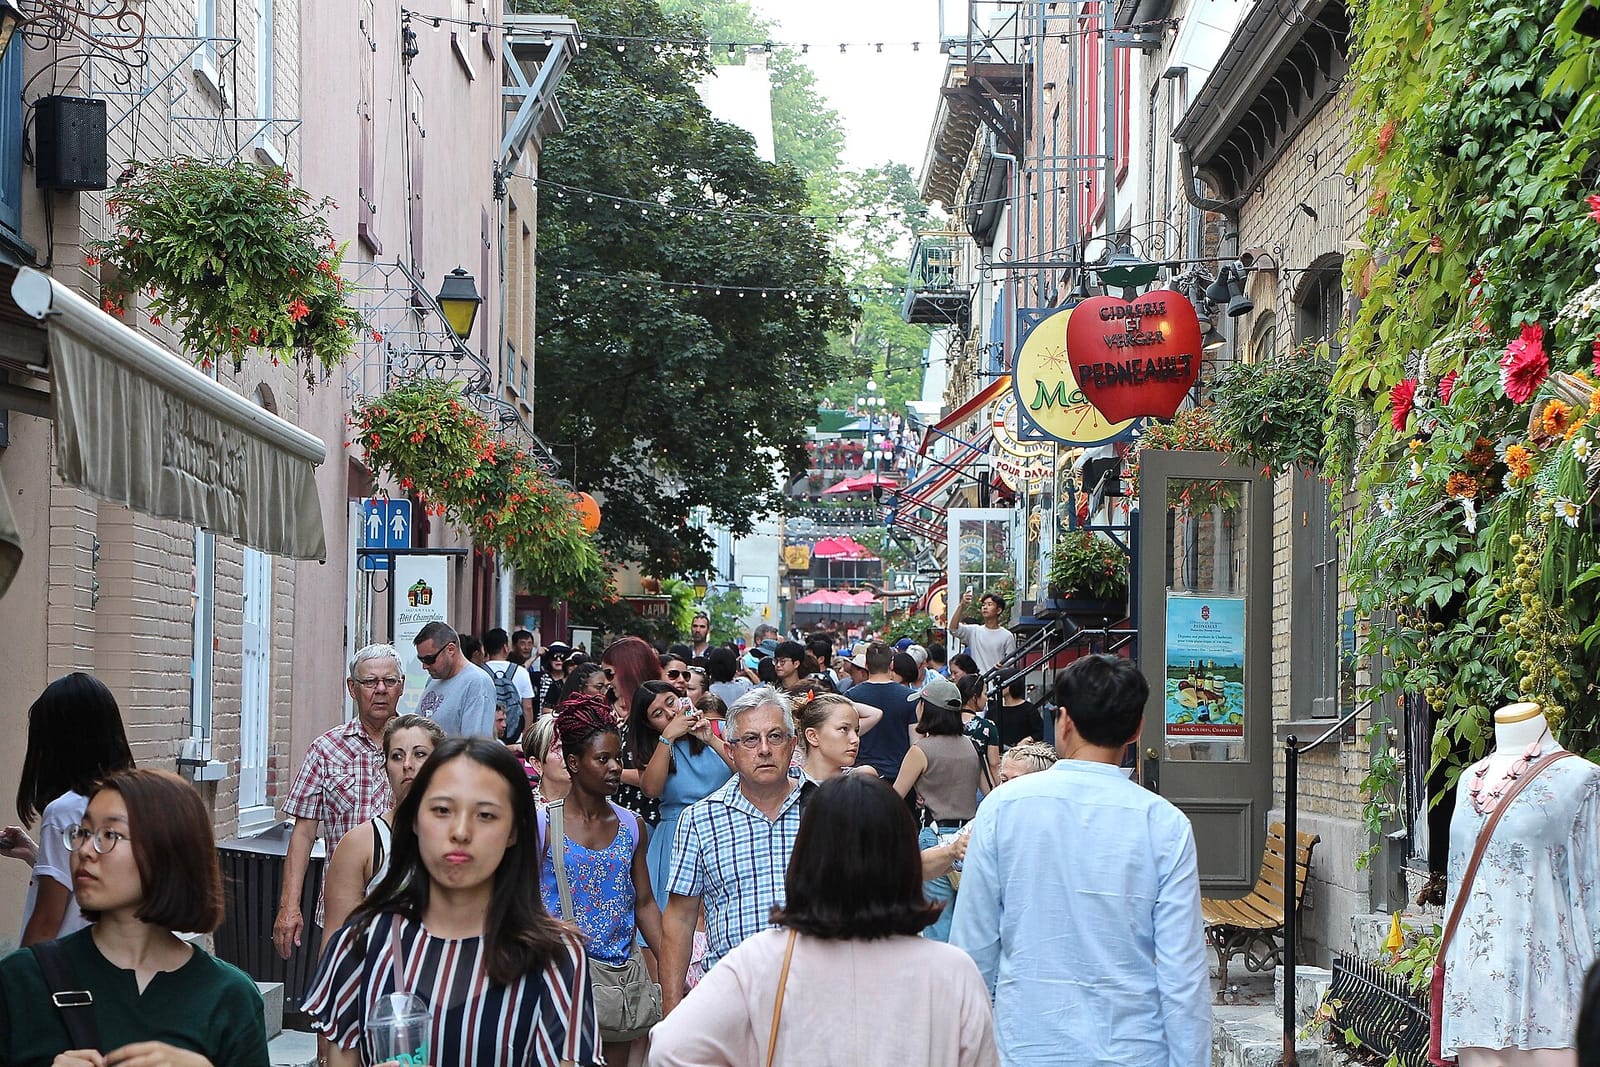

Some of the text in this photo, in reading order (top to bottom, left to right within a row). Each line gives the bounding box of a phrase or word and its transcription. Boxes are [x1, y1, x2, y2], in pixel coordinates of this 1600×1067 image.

[1099, 301, 1167, 321] CIDRERIE
[1125, 317, 1141, 332] ET
[1104, 330, 1165, 348] VERGER
[1078, 353, 1193, 388] PEDNEAULT
[996, 405, 1006, 418] LE
[996, 461, 1021, 478] POUR
